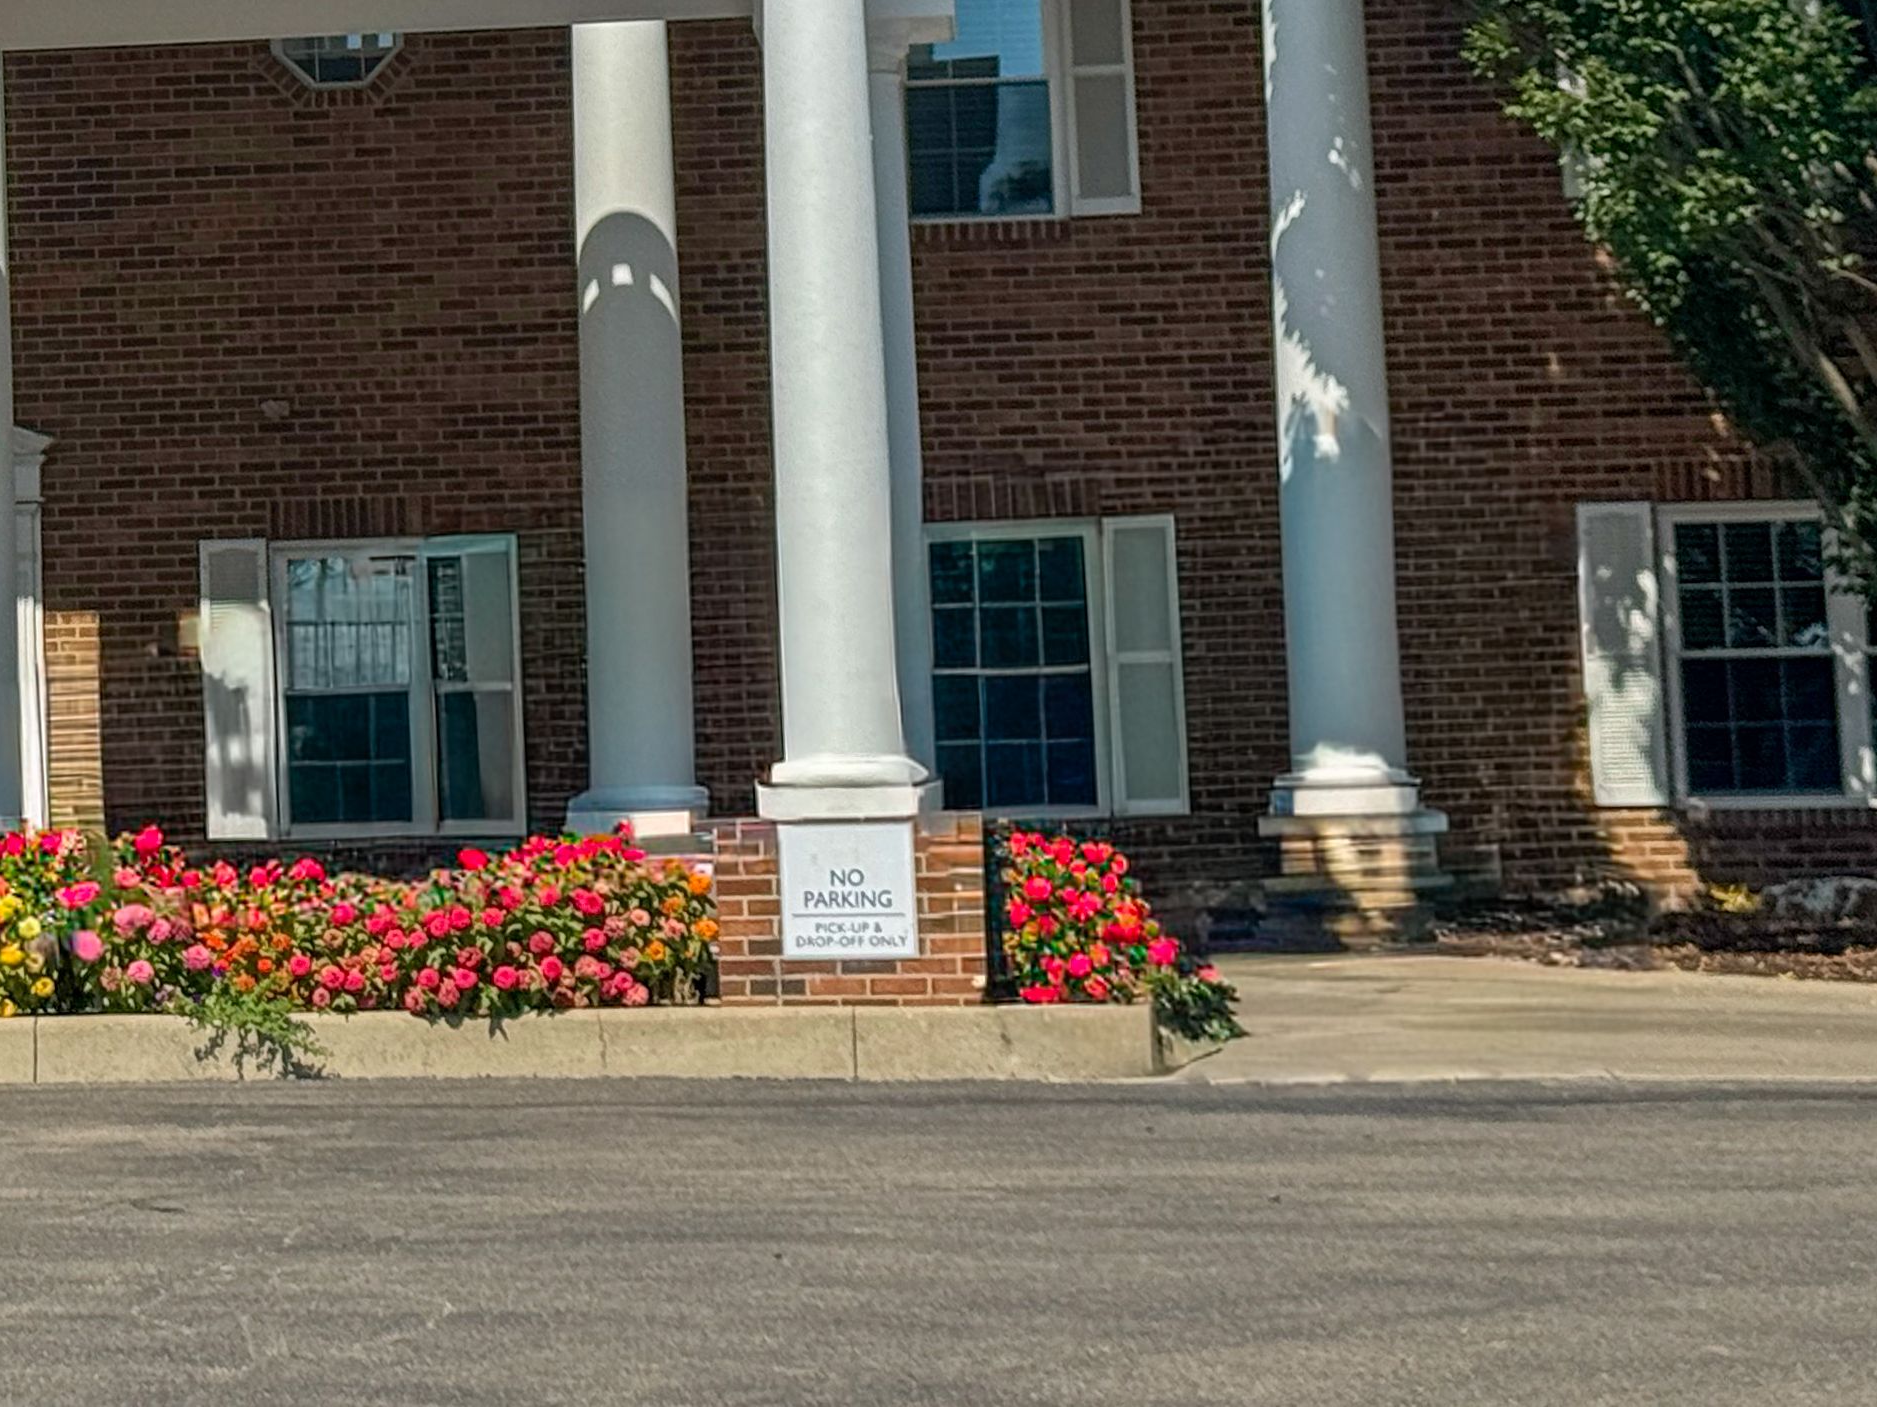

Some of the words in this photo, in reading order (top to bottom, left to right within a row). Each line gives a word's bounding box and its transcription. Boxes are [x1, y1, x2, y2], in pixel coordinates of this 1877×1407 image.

[829, 869, 865, 887] NO
[803, 890, 893, 908] PARKING
[815, 923, 869, 934] PICK-UP
[795, 936, 865, 948] DROP-OFF
[869, 936, 908, 947] ONLY
